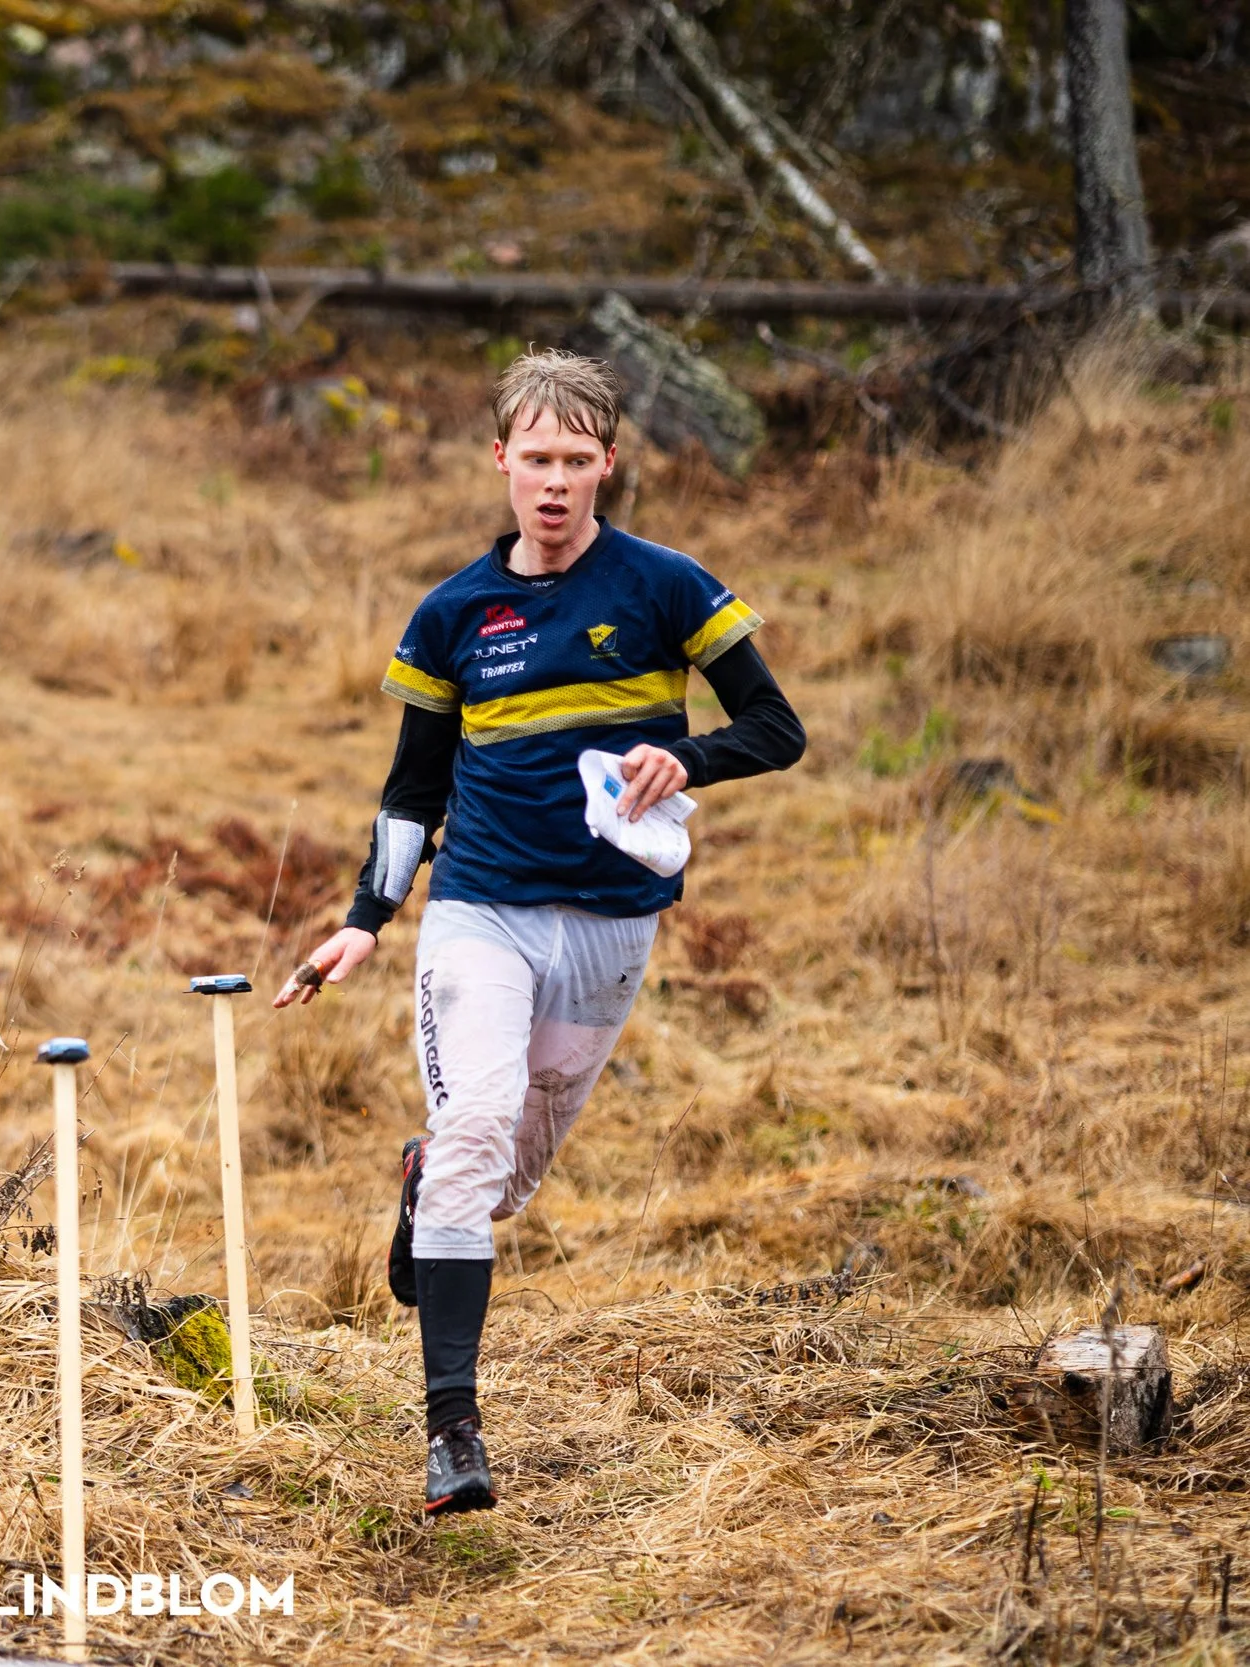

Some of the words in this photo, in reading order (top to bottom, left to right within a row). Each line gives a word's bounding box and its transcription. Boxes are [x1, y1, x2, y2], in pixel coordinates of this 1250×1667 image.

[485, 604, 515, 622] ICA
[481, 618, 524, 635] KVANTUM
[471, 640, 530, 660] JUNET
[481, 660, 526, 679] TRIMTEX
